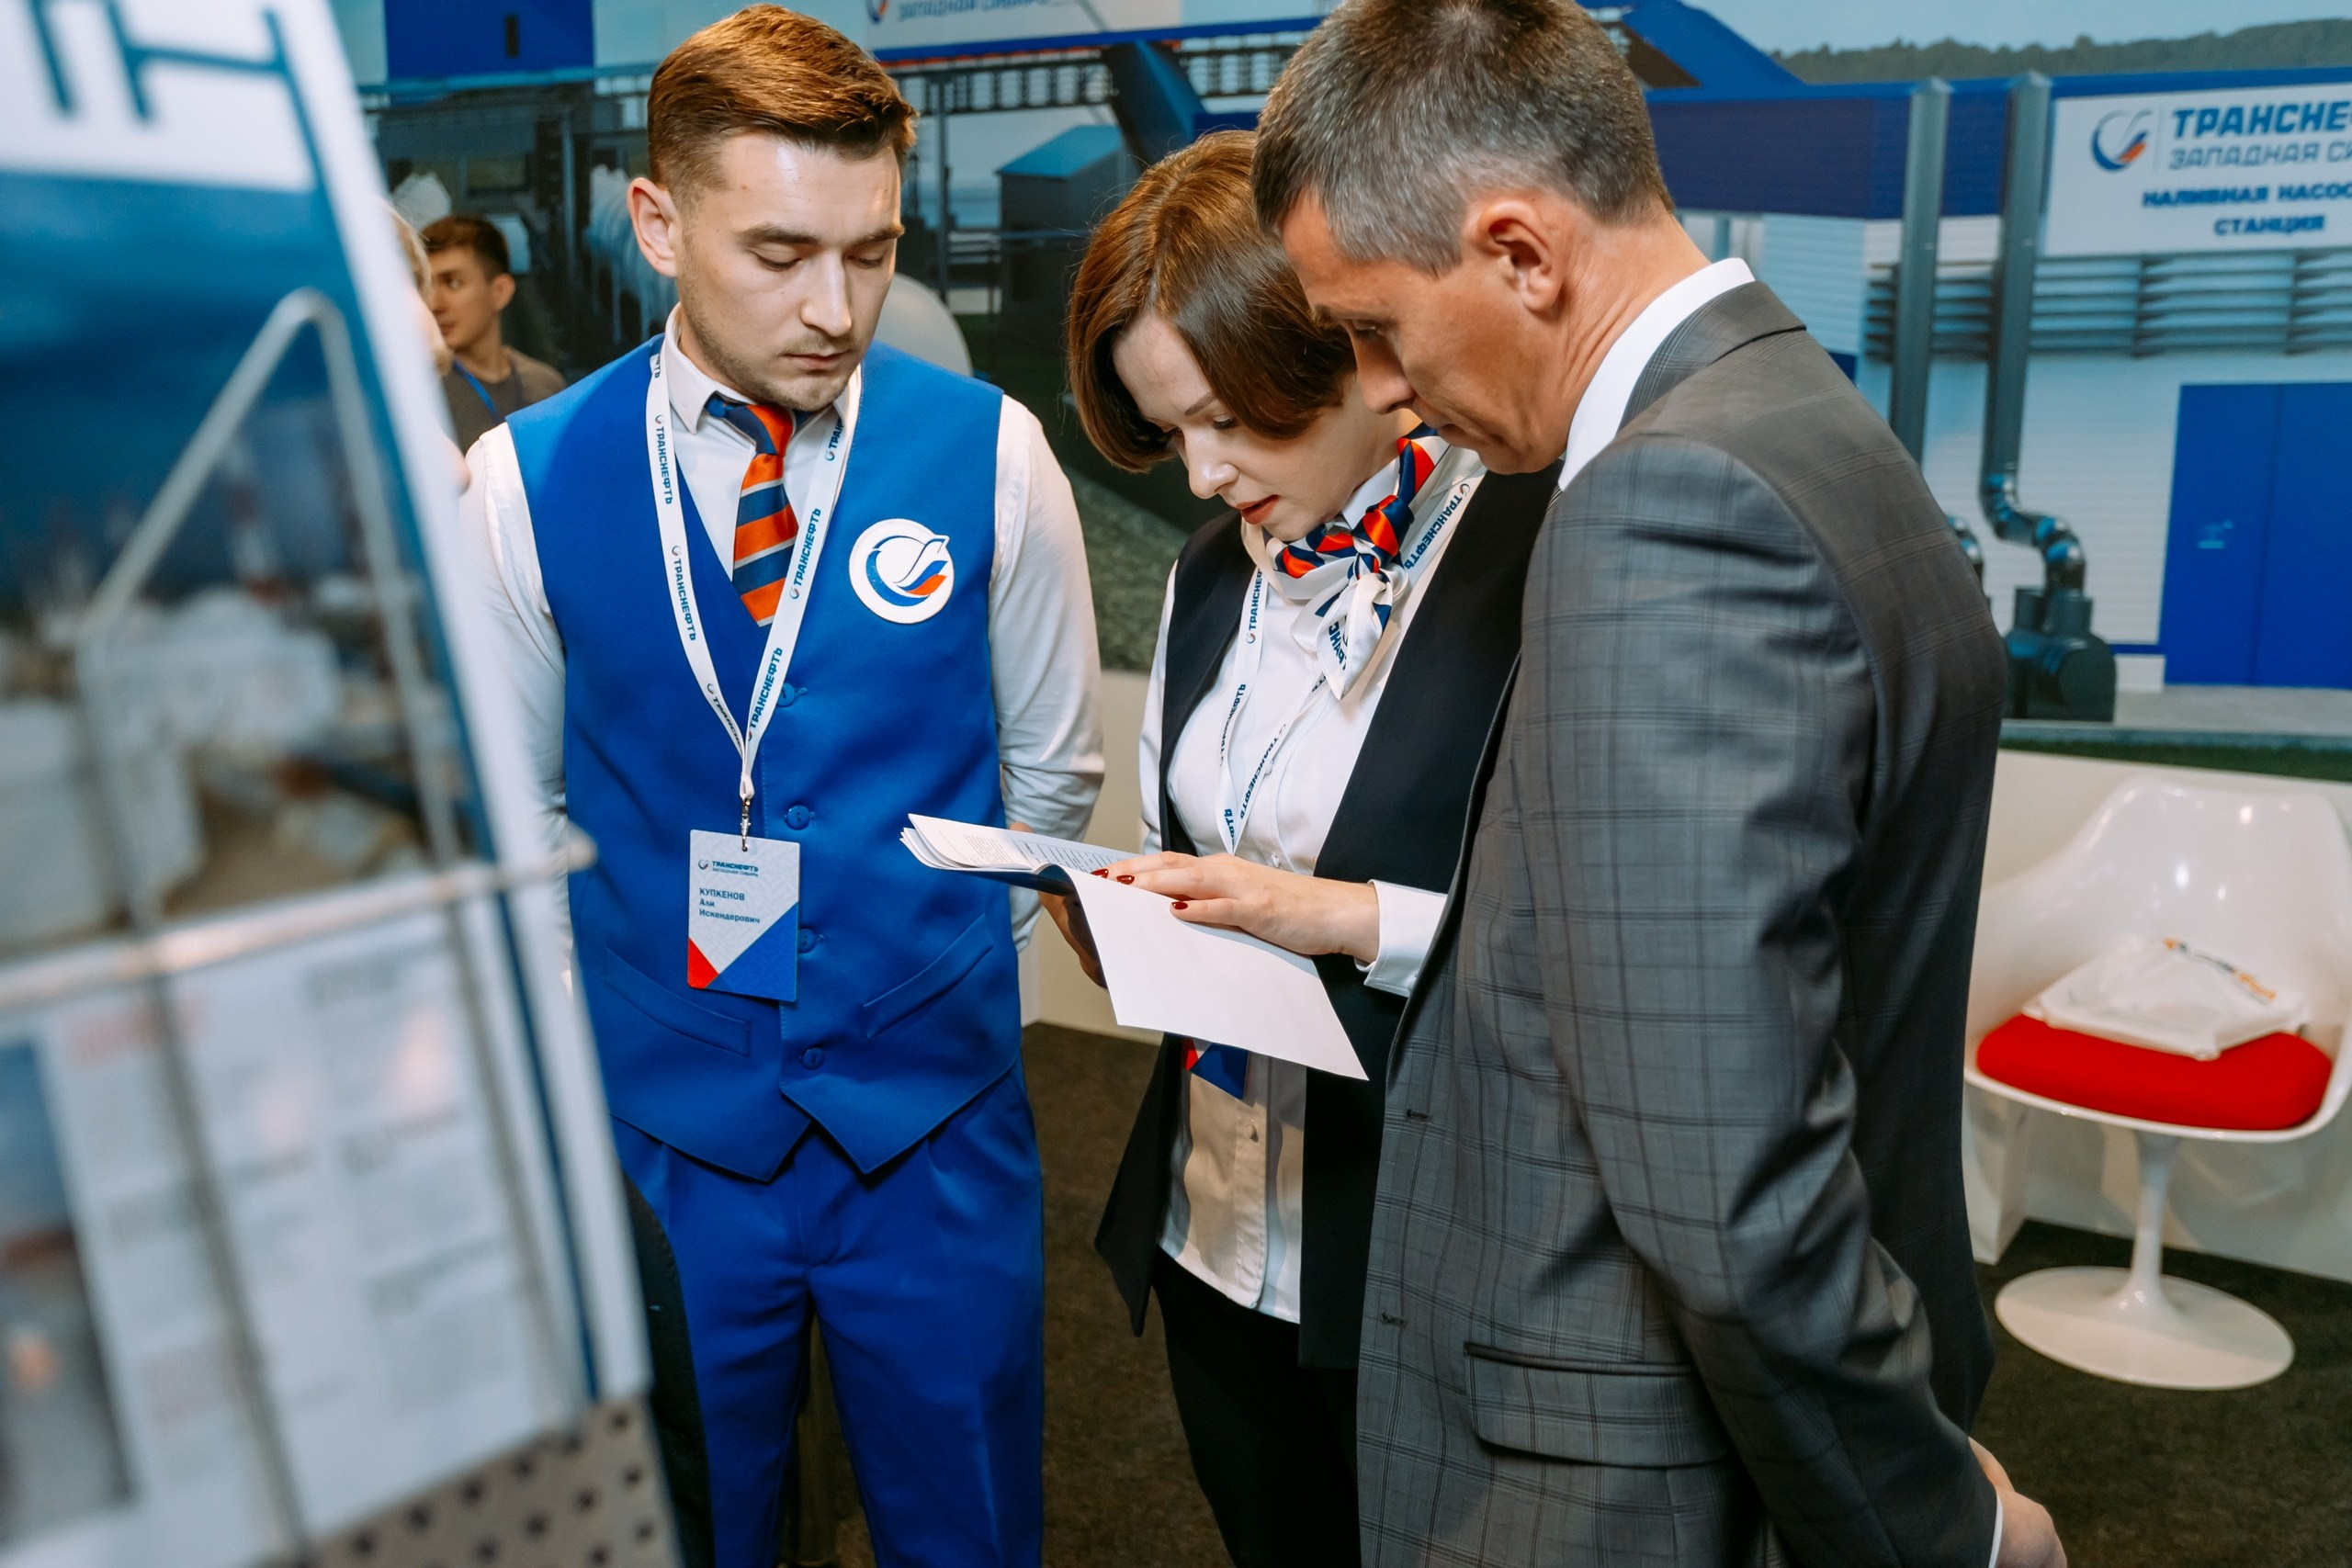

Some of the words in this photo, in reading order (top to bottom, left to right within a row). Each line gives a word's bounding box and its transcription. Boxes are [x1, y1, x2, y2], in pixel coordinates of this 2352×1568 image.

[2173, 100, 2352, 138] ТРАНСНЕ
[2169, 142, 2319, 170] ЗАПАДНАЯ
[656, 426, 673, 504] ТРАНСНЕФТЬ
[793, 508, 821, 587] ТРАНСНЕФТЬ
[1404, 495, 1463, 569] ТРАНСНЕФТЬ
[673, 558, 696, 641] ТРАНСНЕФТЬ
[749, 647, 783, 728] ТРАНСНЕФТЬ
[1239, 737, 1279, 819] ТРАНСНЕФТЬ
[699, 887, 745, 901] КУПКЕНОВ
[712, 860, 759, 872] ТРАНСНЕФТЬ
[699, 898, 715, 908] Али
[699, 908, 761, 924] Искендерович
